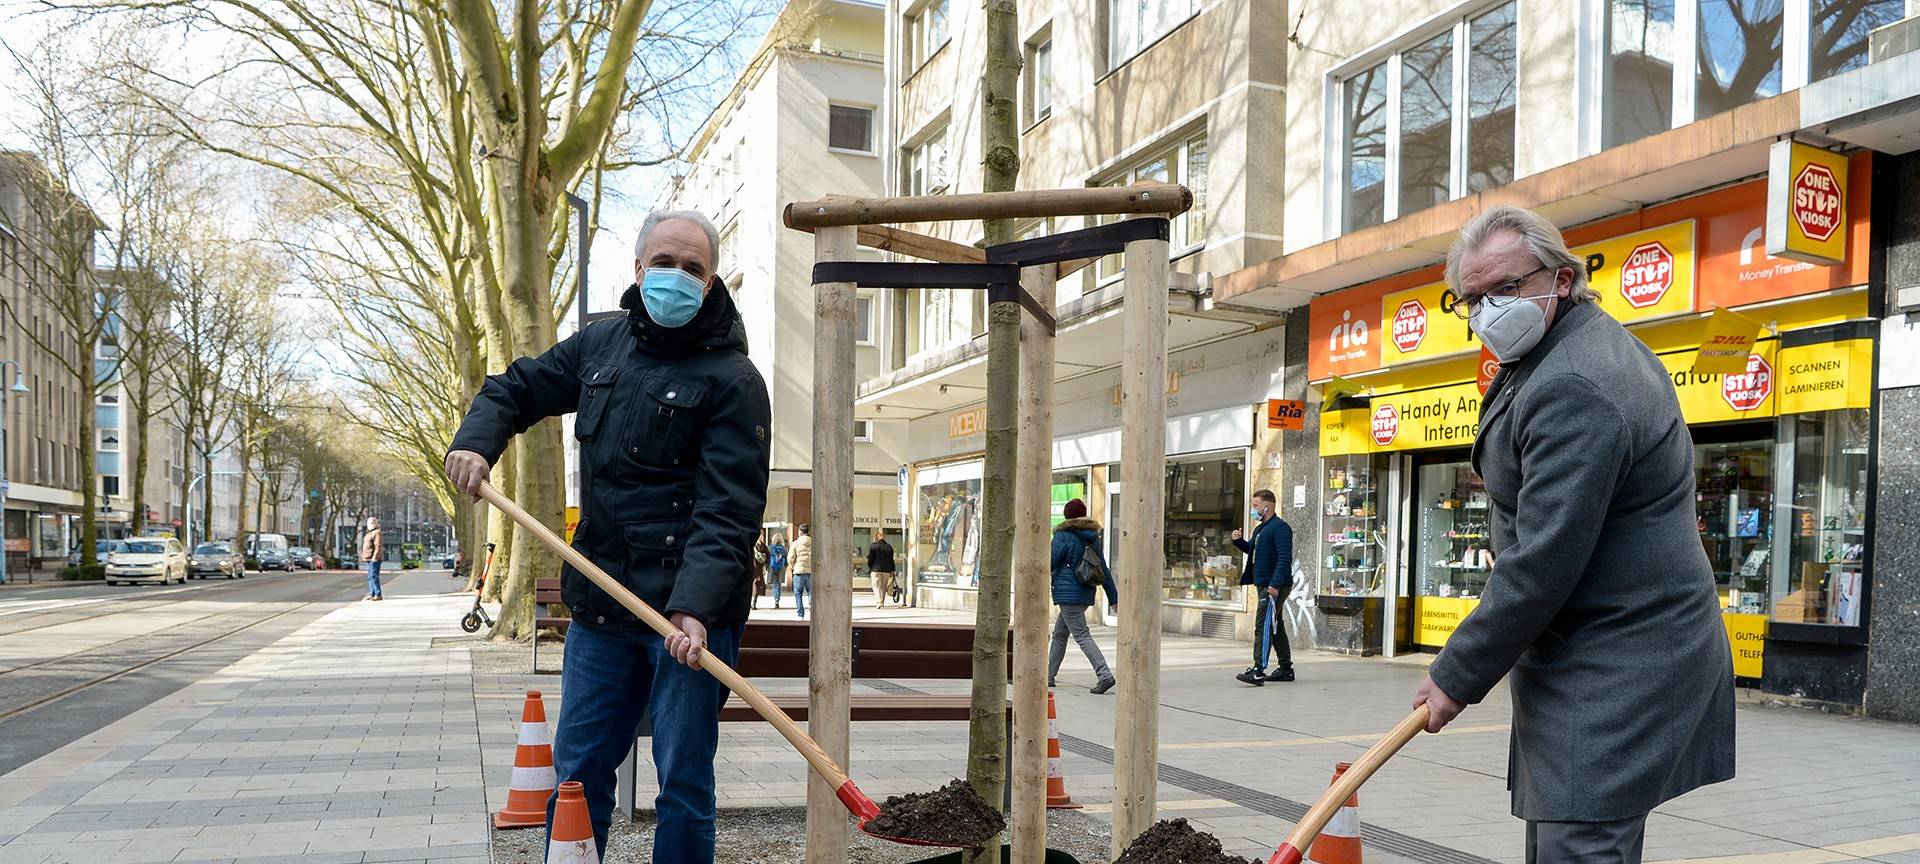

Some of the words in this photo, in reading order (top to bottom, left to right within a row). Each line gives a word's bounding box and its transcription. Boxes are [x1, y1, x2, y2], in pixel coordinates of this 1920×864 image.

[1804, 171, 1830, 191] ONE
[1800, 210, 1832, 229] KIOSK
[1632, 249, 1660, 267] ONE
[1739, 268, 1774, 282] Money
[1629, 281, 1663, 297] KIOSK
[1400, 306, 1419, 319] ONE
[1329, 309, 1368, 352] ria
[1712, 335, 1746, 345] DHL
[1789, 359, 1841, 376] SCANNEN
[1730, 389, 1762, 401] KIOSK
[1784, 379, 1845, 395] LAMINIEREN
[1277, 401, 1303, 418] Ria
[1401, 398, 1451, 421] Handy
[1420, 611, 1459, 620] LEBENSMITTEL
